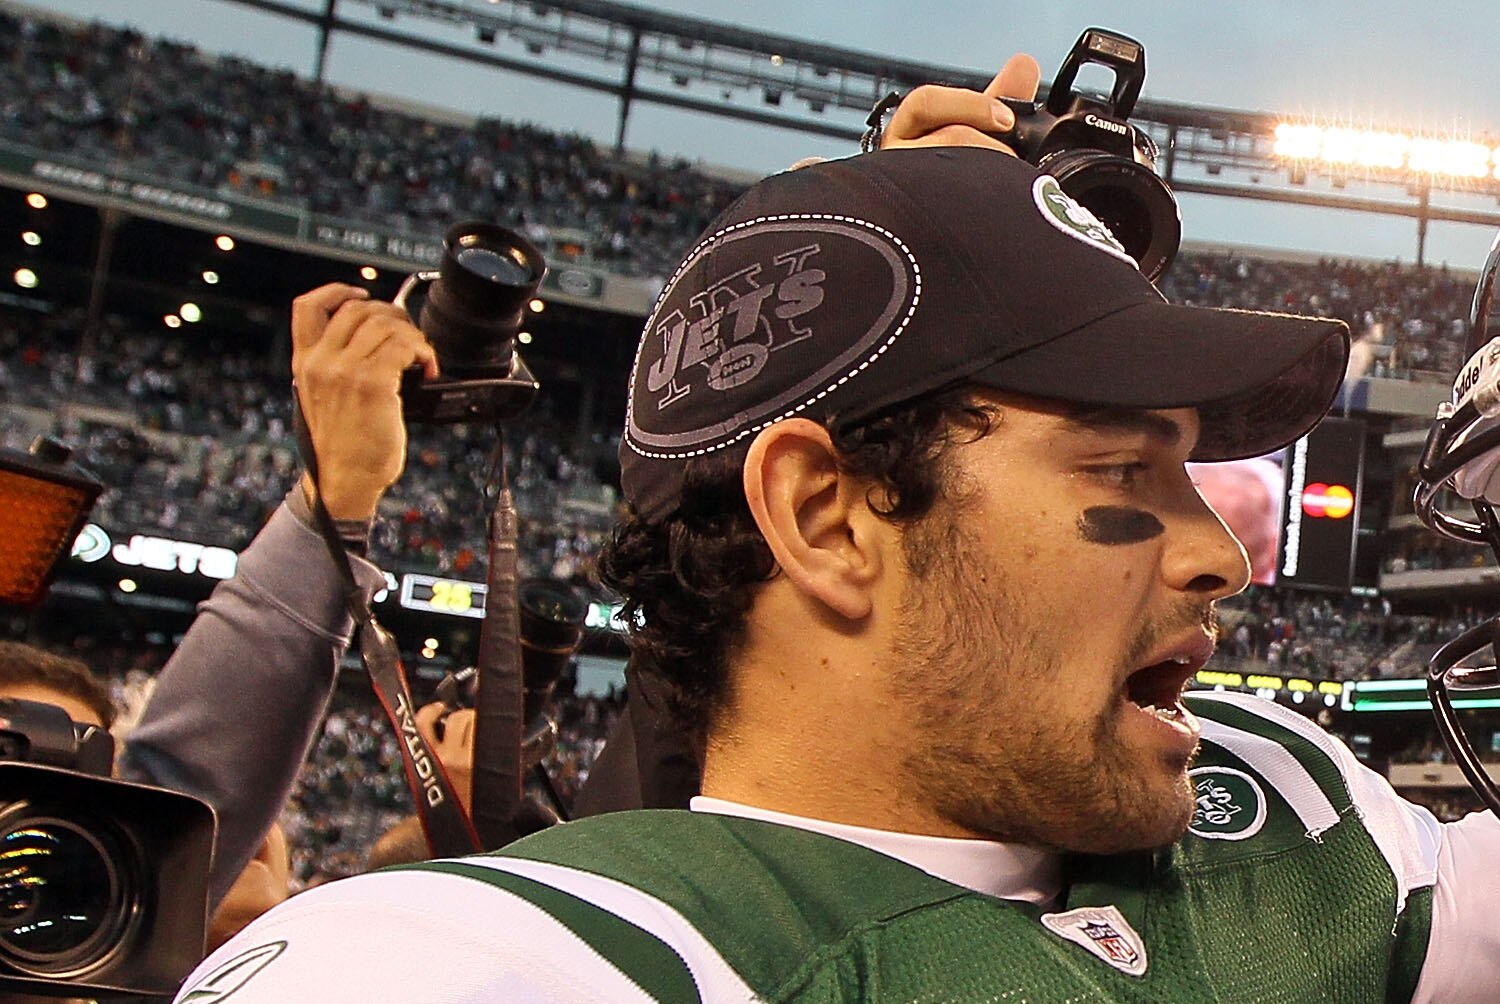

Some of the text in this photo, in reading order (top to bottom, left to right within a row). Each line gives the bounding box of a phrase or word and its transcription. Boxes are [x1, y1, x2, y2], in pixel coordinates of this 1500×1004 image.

[1084, 113, 1128, 136] Canon
[647, 268, 827, 392] JETS
[111, 534, 239, 580] JETS
[395, 693, 445, 808] DIGITAL
